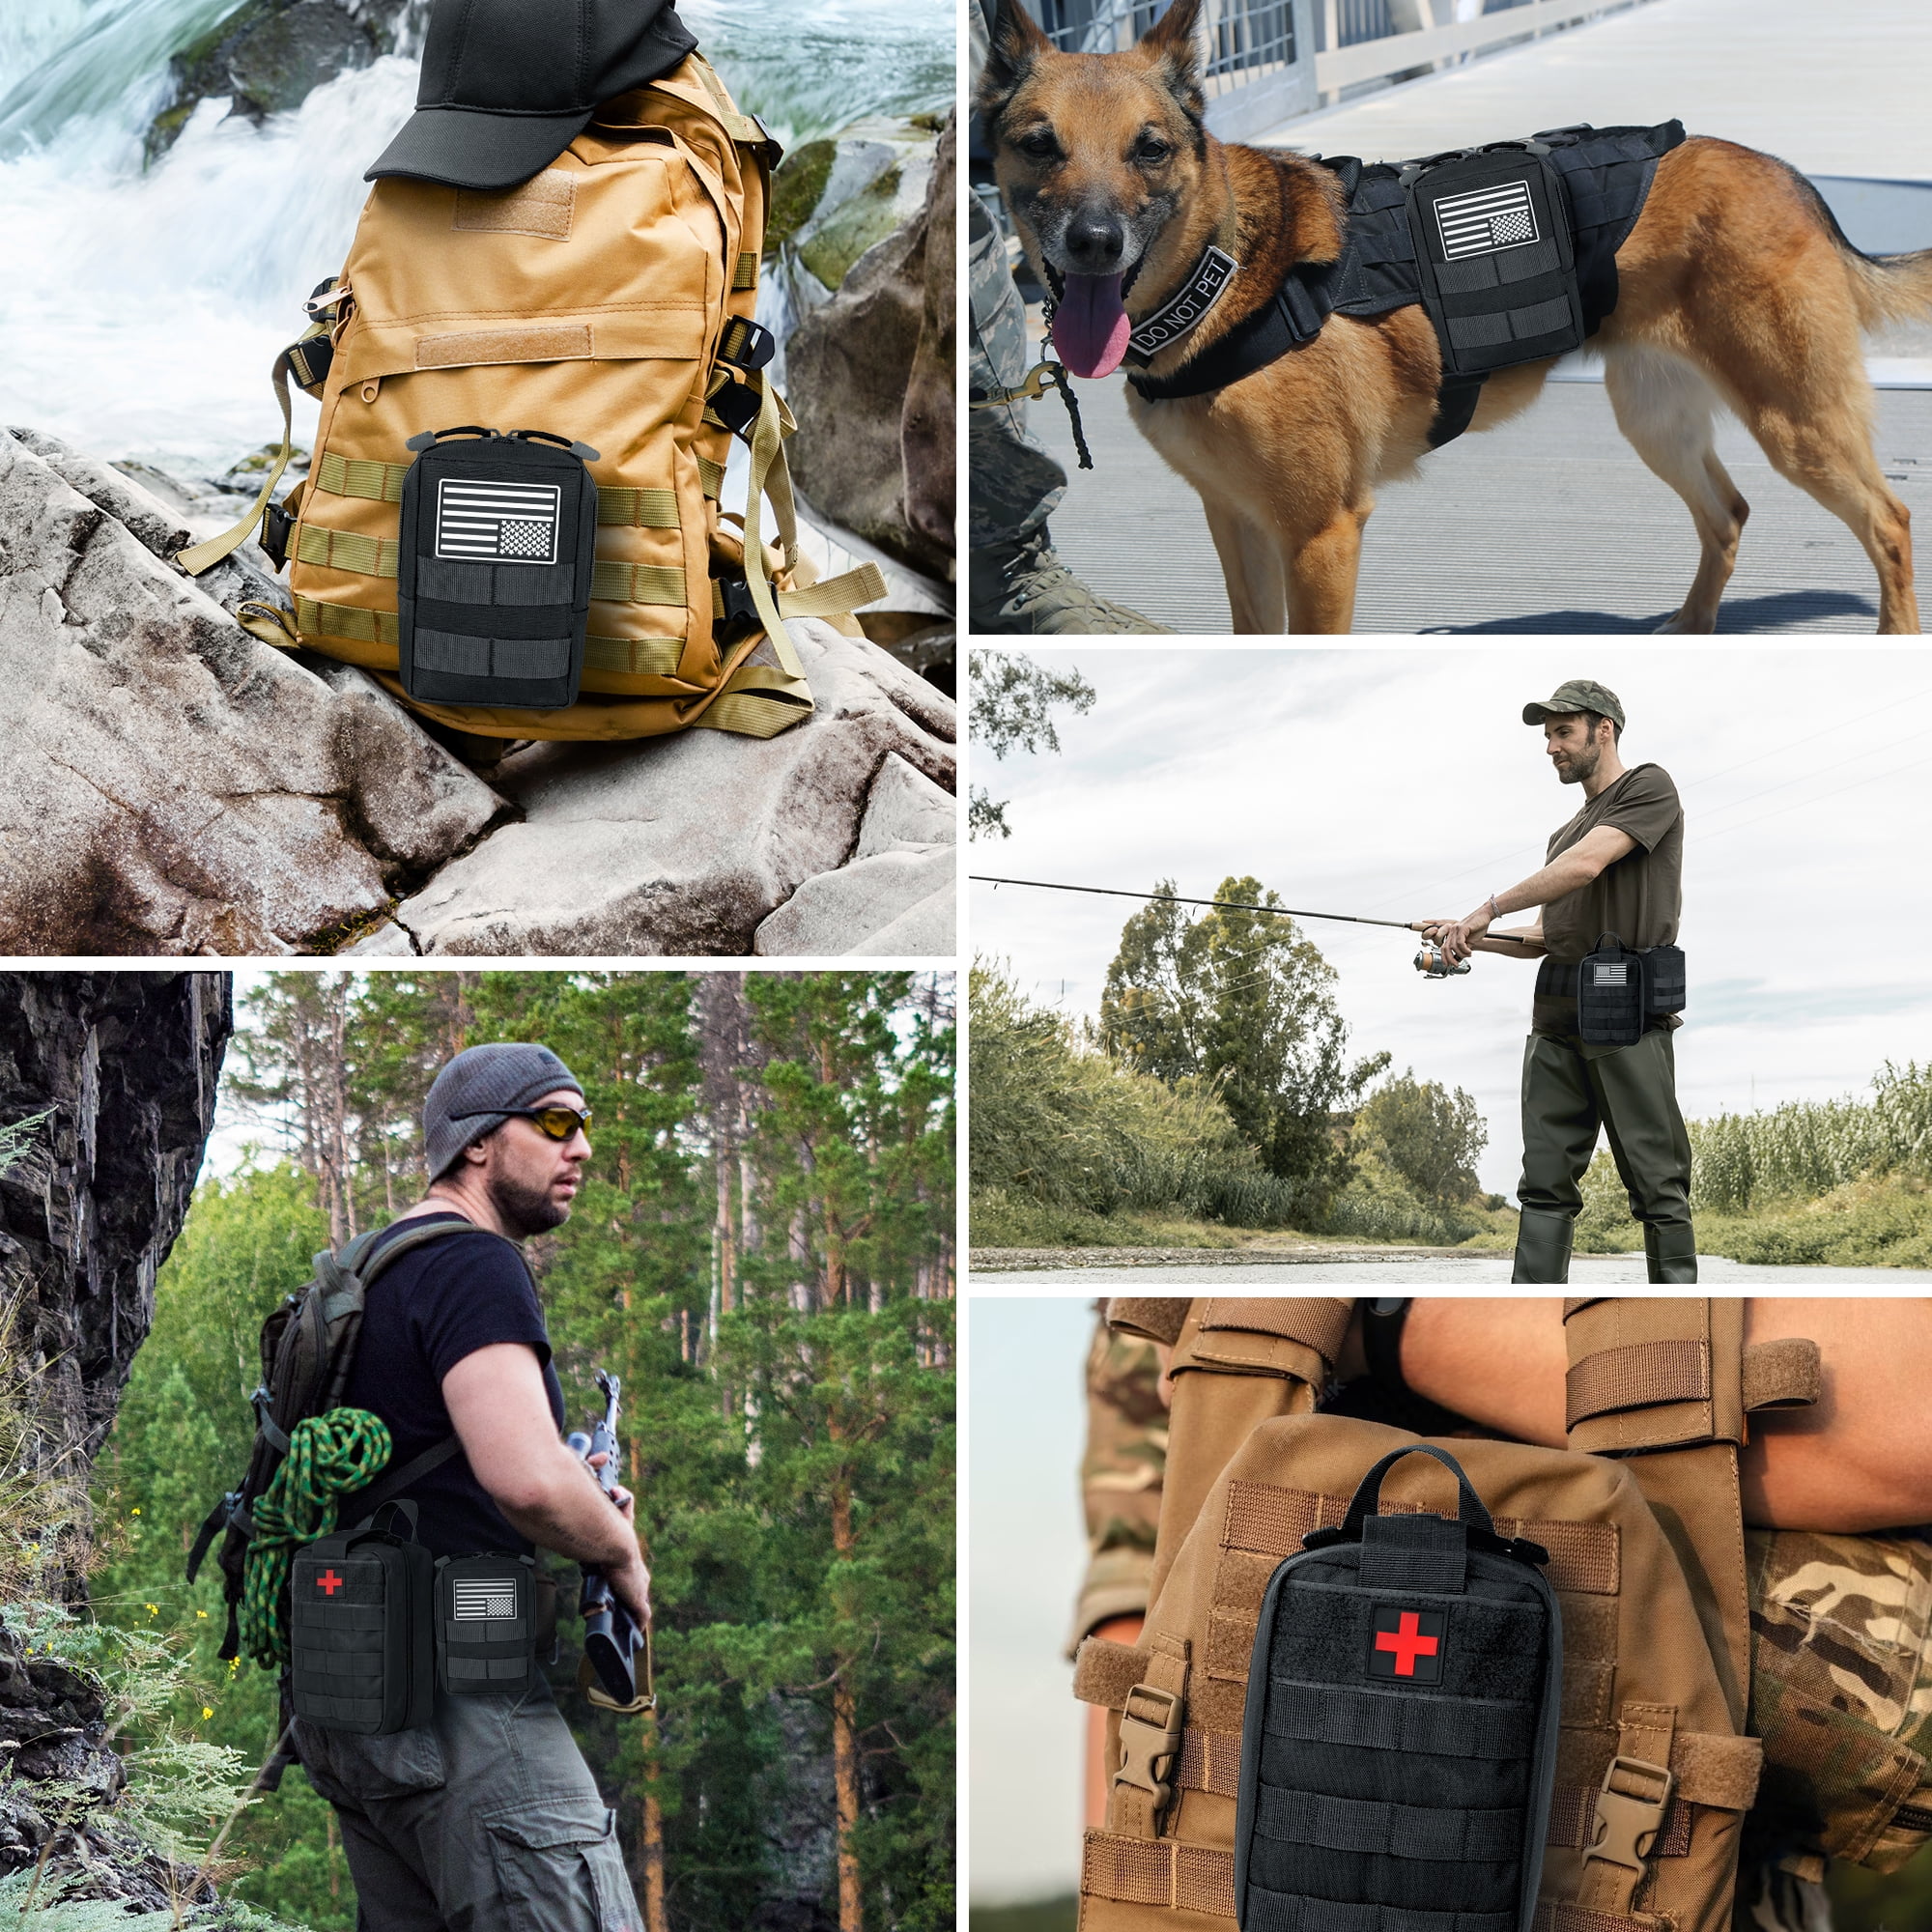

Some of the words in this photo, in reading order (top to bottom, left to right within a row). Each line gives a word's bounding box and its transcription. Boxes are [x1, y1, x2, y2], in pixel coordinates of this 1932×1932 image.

[1135, 327, 1169, 347] DO
[1163, 295, 1202, 329] NOT
[1195, 257, 1226, 298] PET
